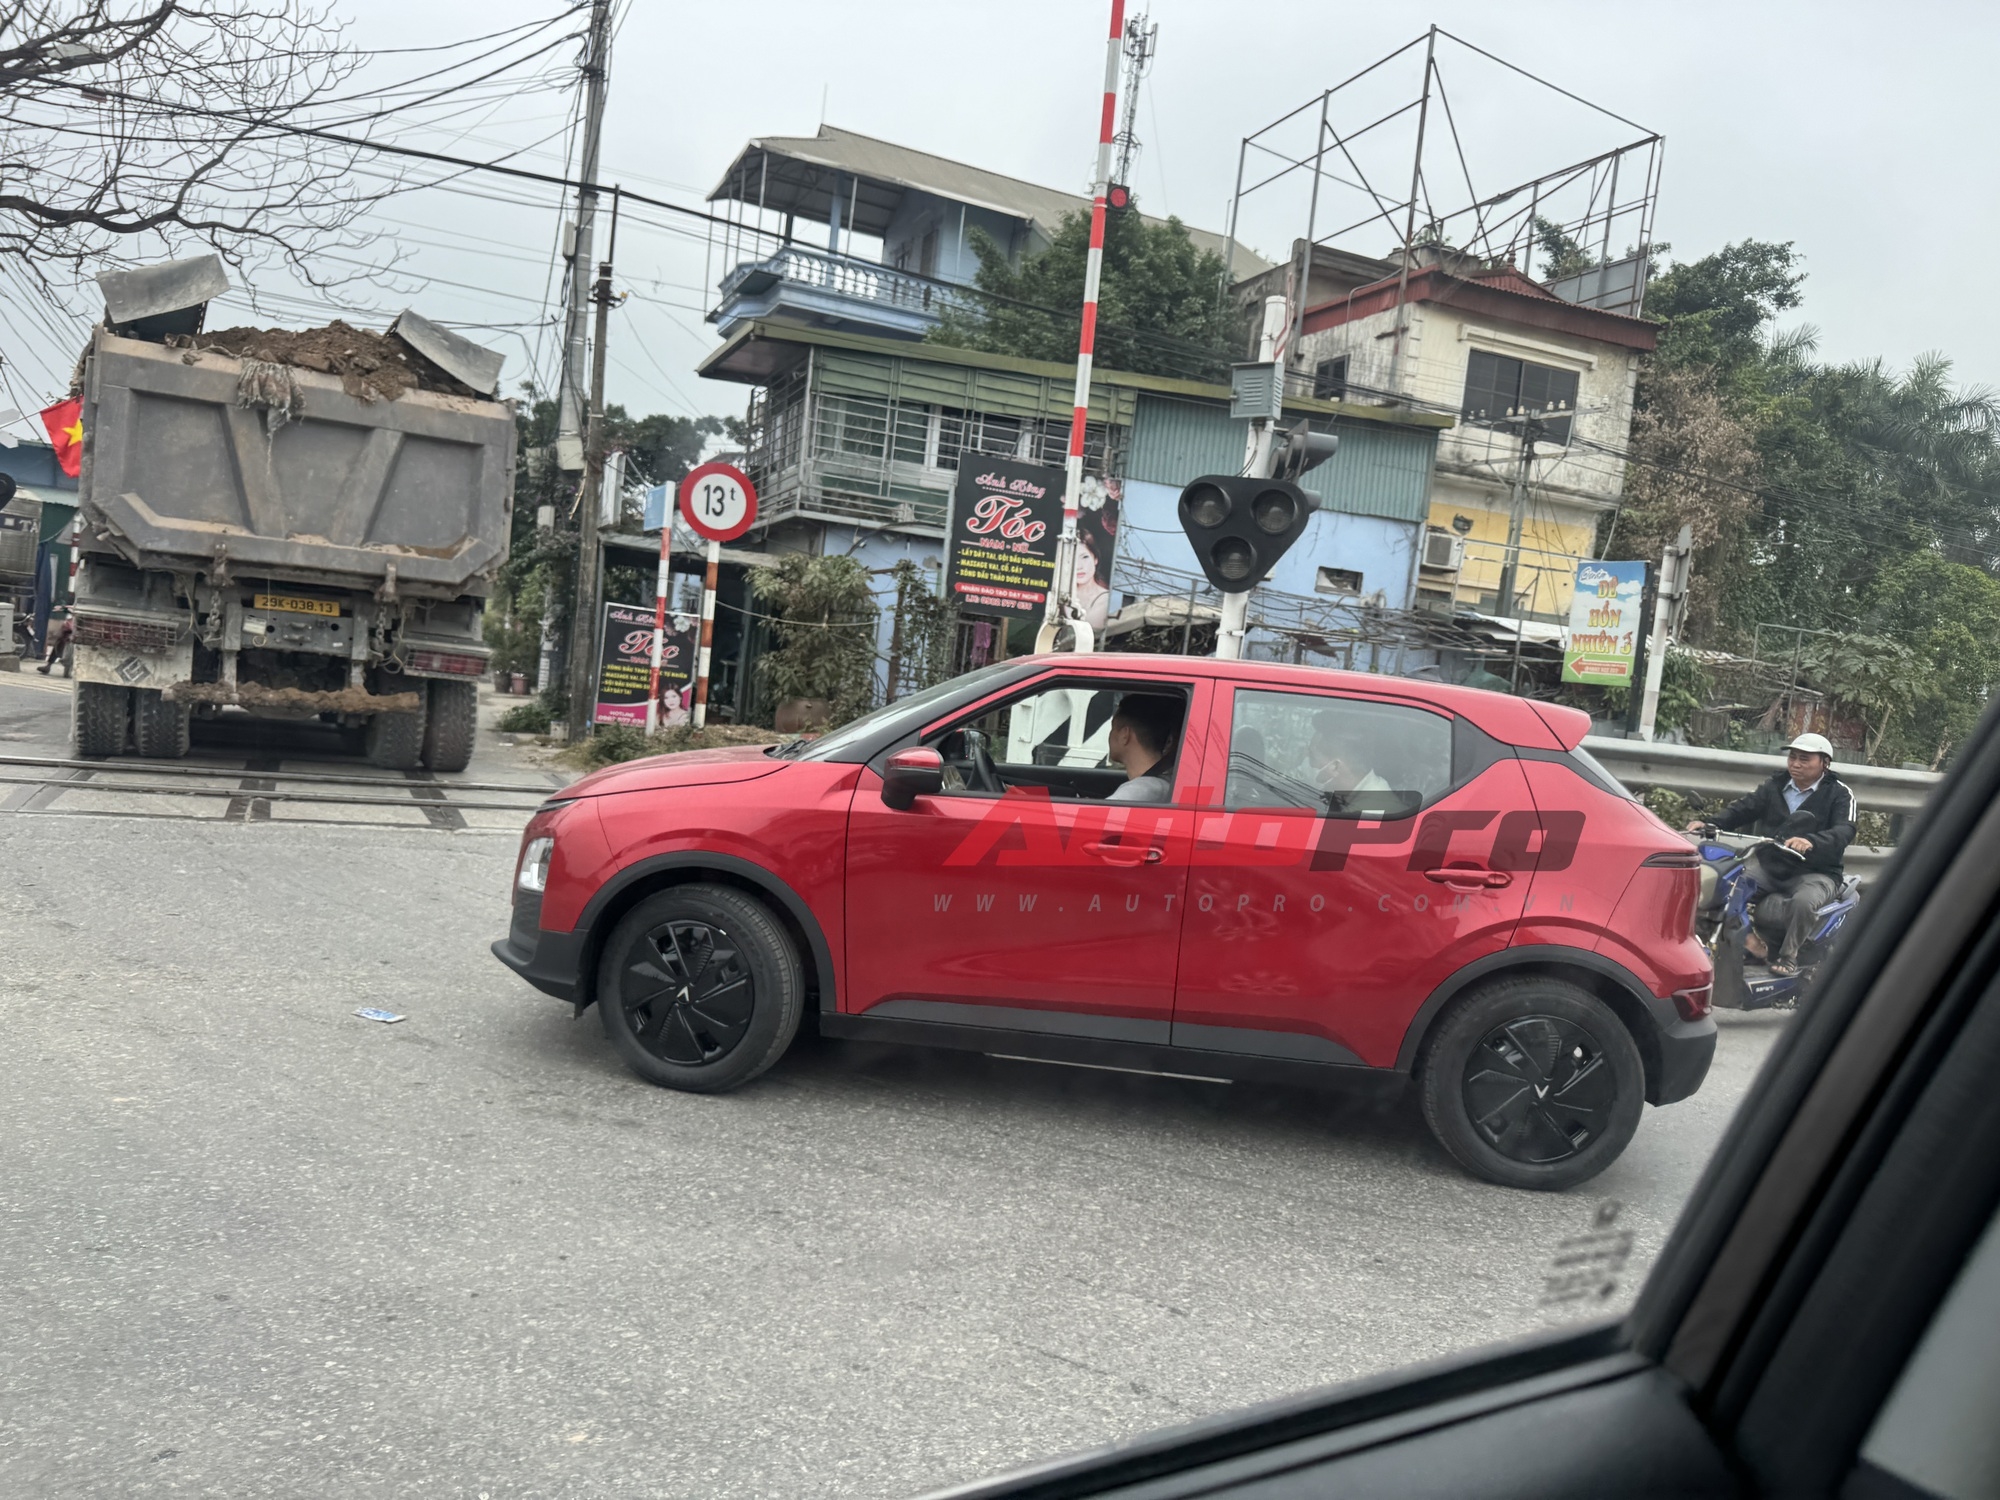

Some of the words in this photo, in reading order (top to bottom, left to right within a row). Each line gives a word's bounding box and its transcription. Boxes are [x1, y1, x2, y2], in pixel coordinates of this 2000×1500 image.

[704, 484, 725, 517] 13
[730, 487, 736, 501] t
[966, 495, 1046, 542] Tóc
[980, 537, 1005, 550] NAM
[261, 596, 333, 613] 29K-038.13
[1570, 629, 1619, 654] NHIÊN
